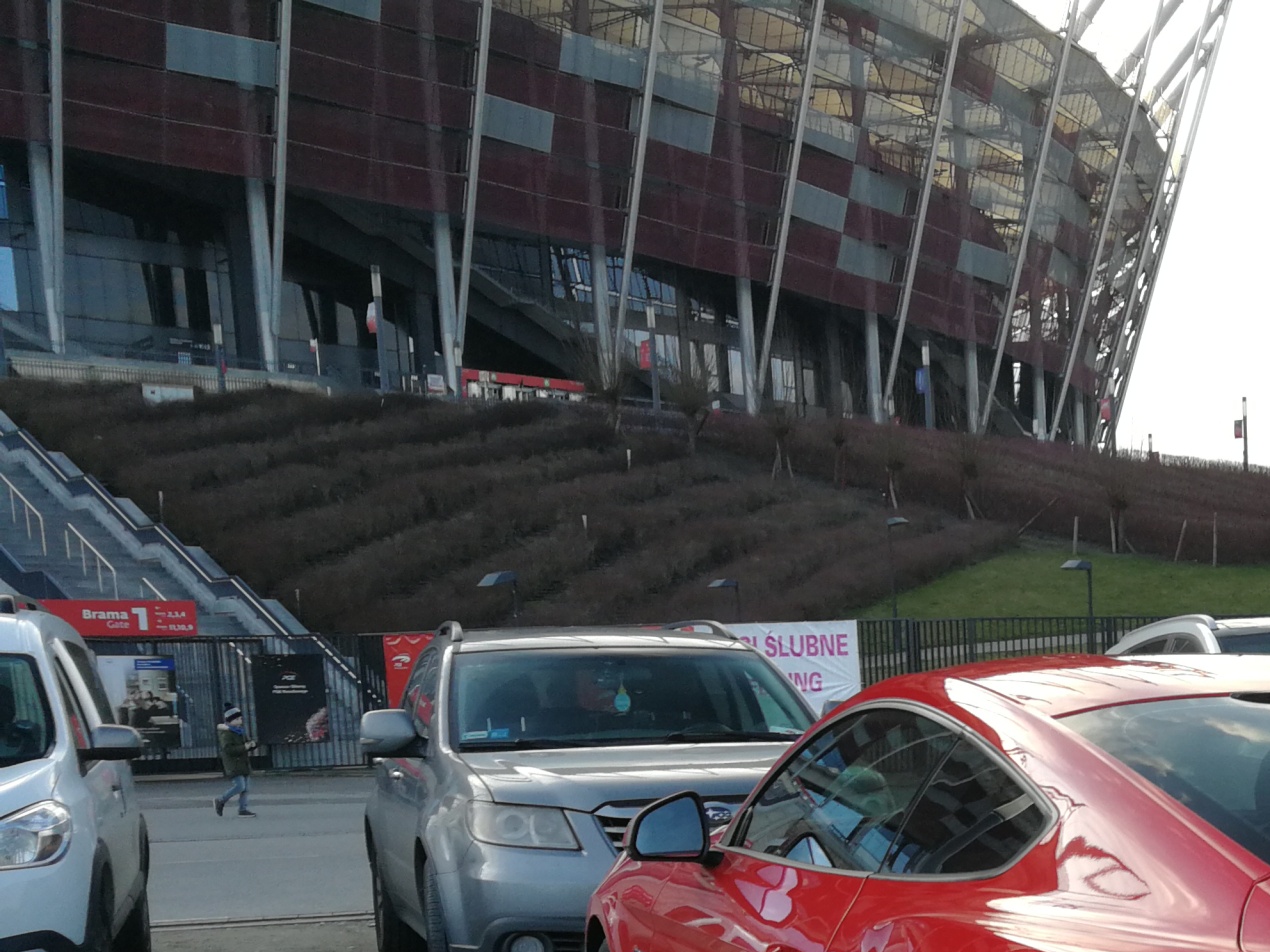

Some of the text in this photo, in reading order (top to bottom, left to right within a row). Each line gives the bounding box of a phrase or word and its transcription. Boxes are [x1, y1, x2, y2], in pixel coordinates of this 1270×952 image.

[82, 607, 149, 631] Brama 1
[106, 620, 130, 629] Gate
[764, 631, 849, 658] ŚLUBNE
